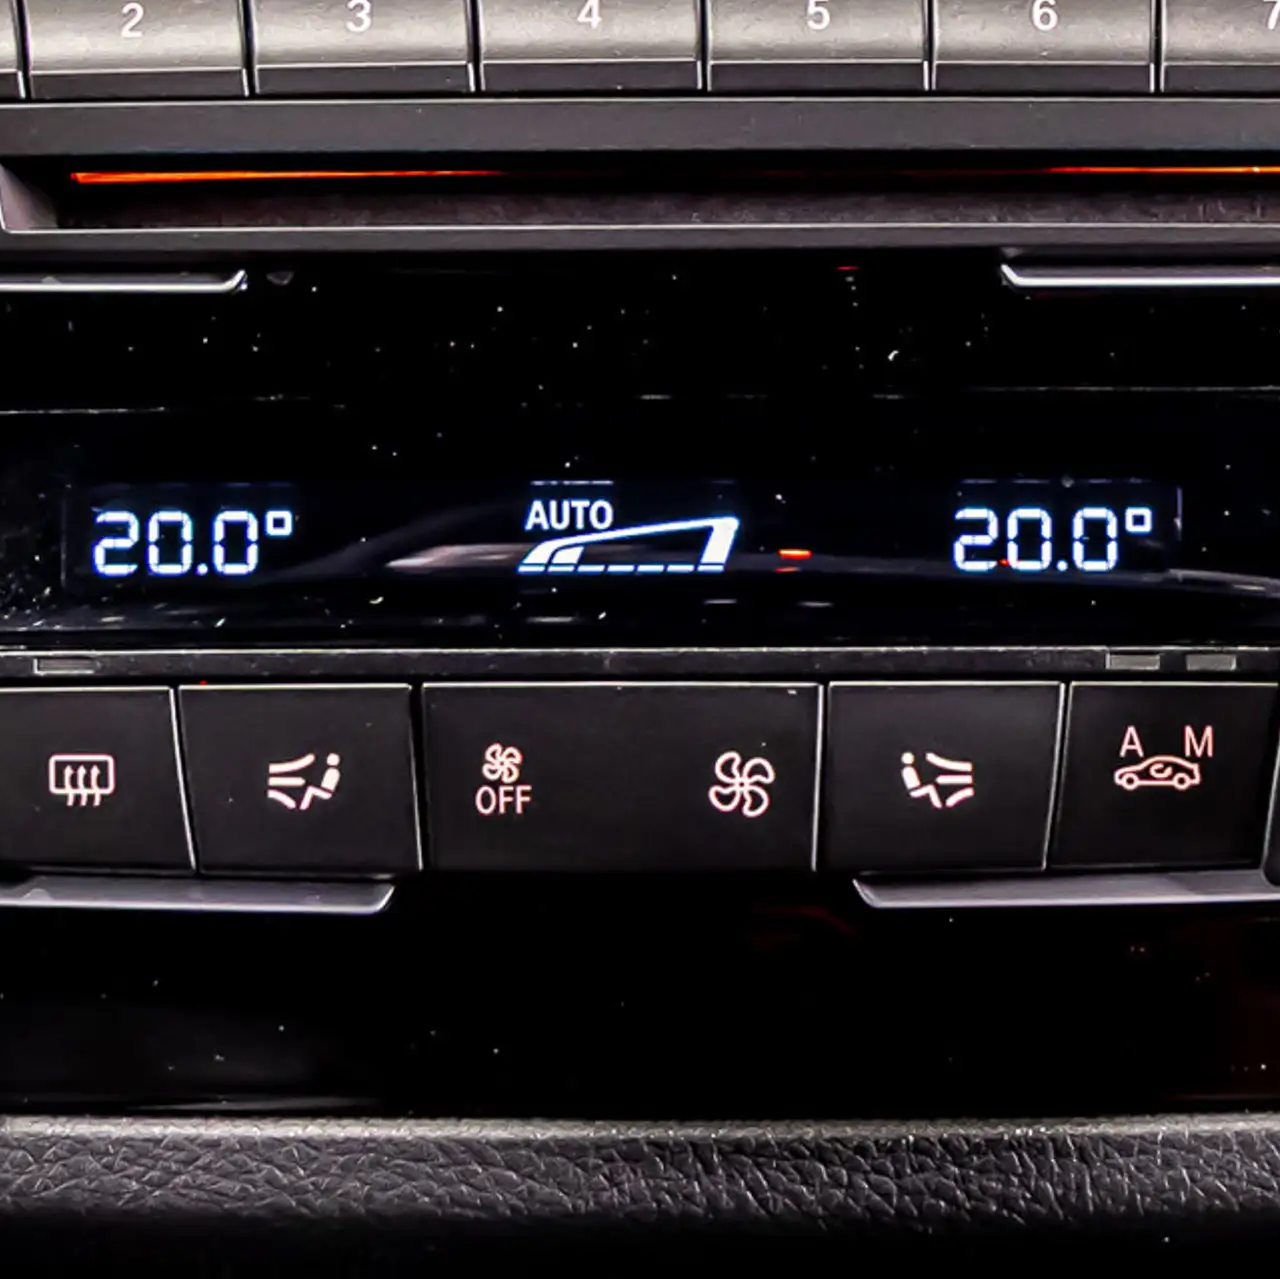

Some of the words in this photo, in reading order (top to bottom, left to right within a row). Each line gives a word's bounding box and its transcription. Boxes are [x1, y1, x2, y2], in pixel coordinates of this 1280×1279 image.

[120, 3, 144, 38] 2
[526, 500, 613, 532] AUTO
[1120, 726, 1143, 757] A
[1184, 726, 1213, 757] M
[476, 785, 531, 814] OFF
